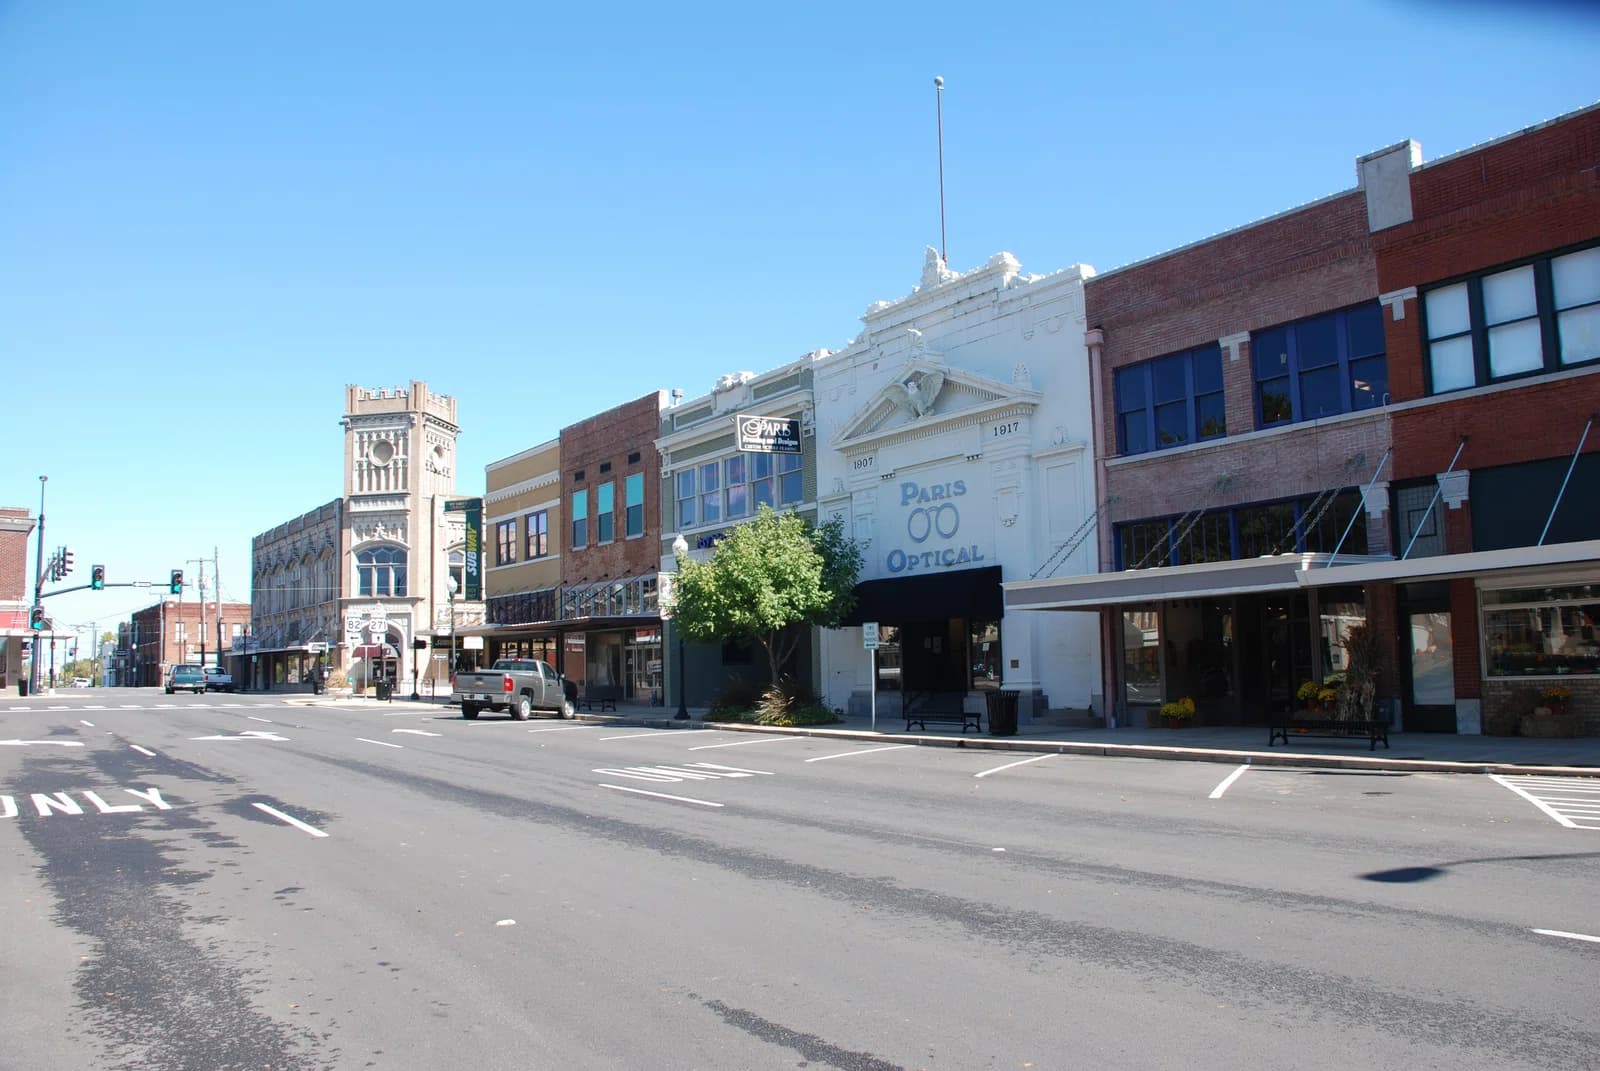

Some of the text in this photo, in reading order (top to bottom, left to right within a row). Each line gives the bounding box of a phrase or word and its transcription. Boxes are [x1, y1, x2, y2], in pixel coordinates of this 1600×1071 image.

[743, 418, 791, 437] PARIS
[993, 421, 1019, 437] 1917
[853, 457, 874, 470] 1907
[901, 480, 967, 506] PARIS
[466, 521, 478, 576] SUBWAY
[887, 545, 985, 573] OPTICAL
[348, 621, 361, 630] 82
[370, 621, 387, 630] 271
